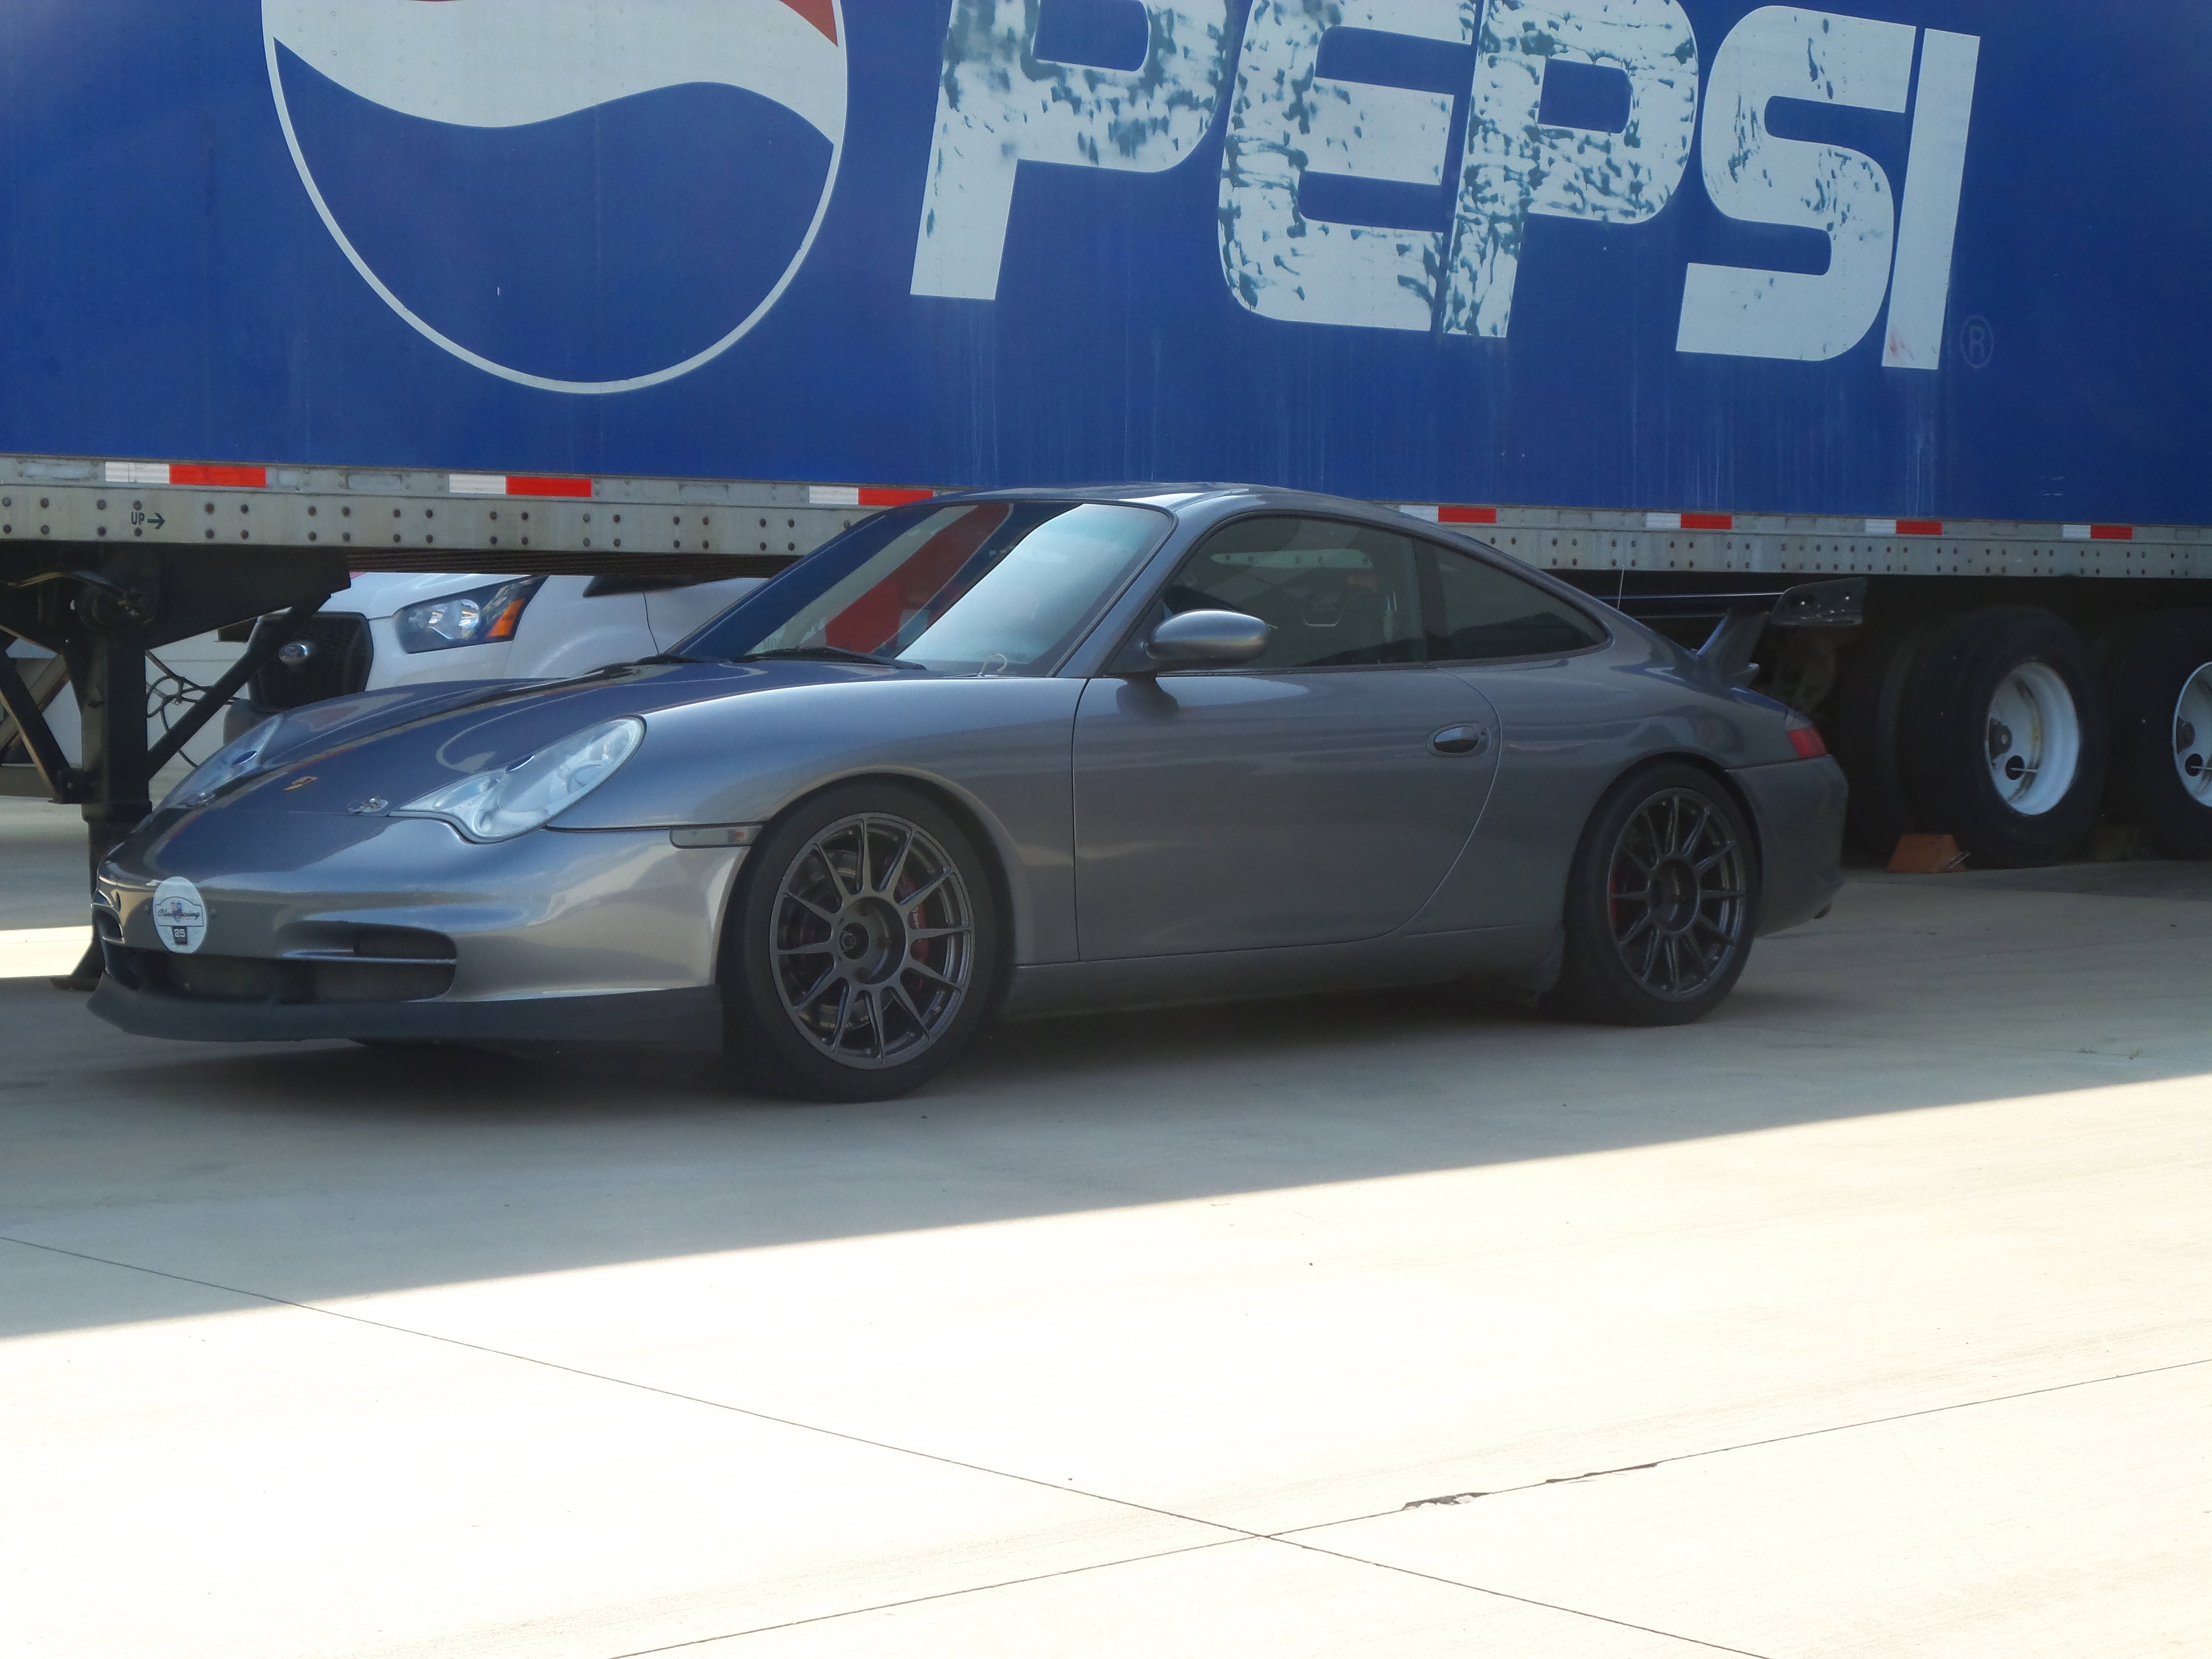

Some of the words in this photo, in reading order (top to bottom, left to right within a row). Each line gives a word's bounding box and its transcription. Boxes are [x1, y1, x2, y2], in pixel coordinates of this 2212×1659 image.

[910, 0, 1981, 370] PEPSI
[131, 512, 144, 525] UP
[174, 928, 185, 938] 25
